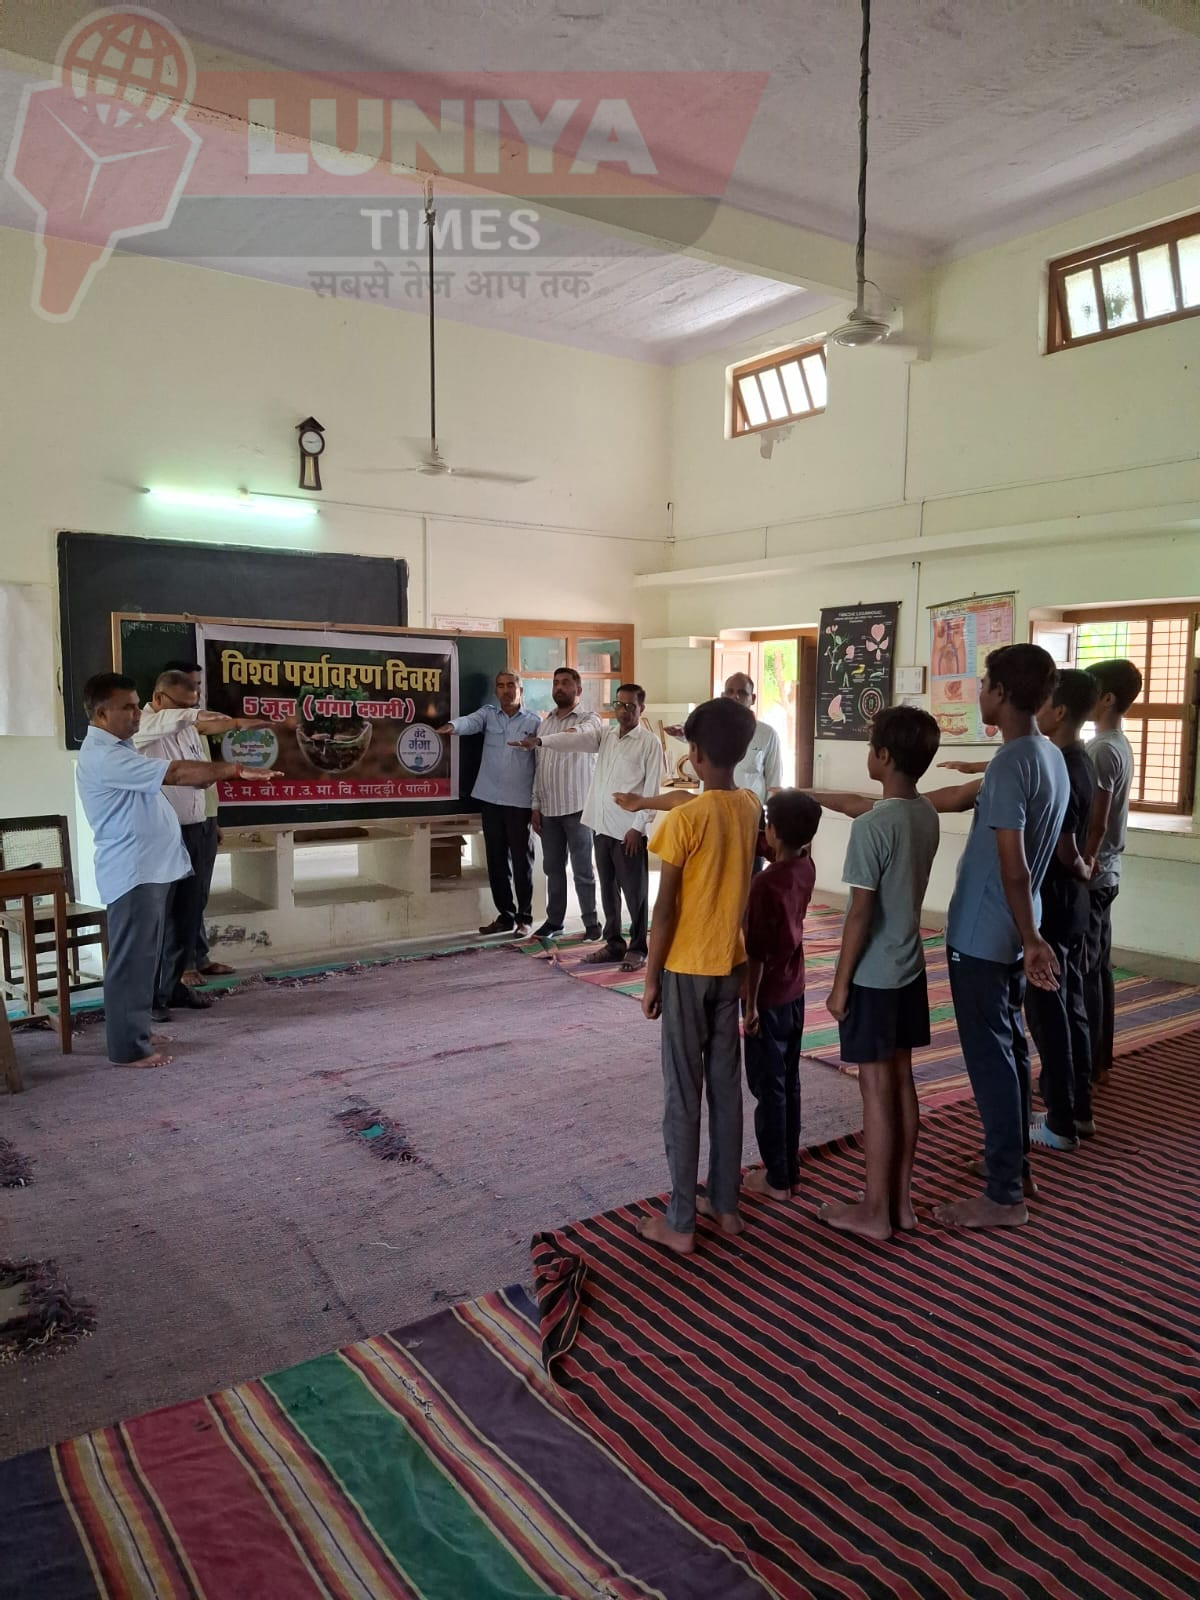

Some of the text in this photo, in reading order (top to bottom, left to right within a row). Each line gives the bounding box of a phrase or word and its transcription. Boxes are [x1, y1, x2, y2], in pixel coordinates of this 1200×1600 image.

[220, 649, 442, 693] विश्व पर्यावरण दिवस
[243, 696, 259, 715] 5
[261, 697, 297, 722] जून
[407, 738, 432, 751] गंगा
